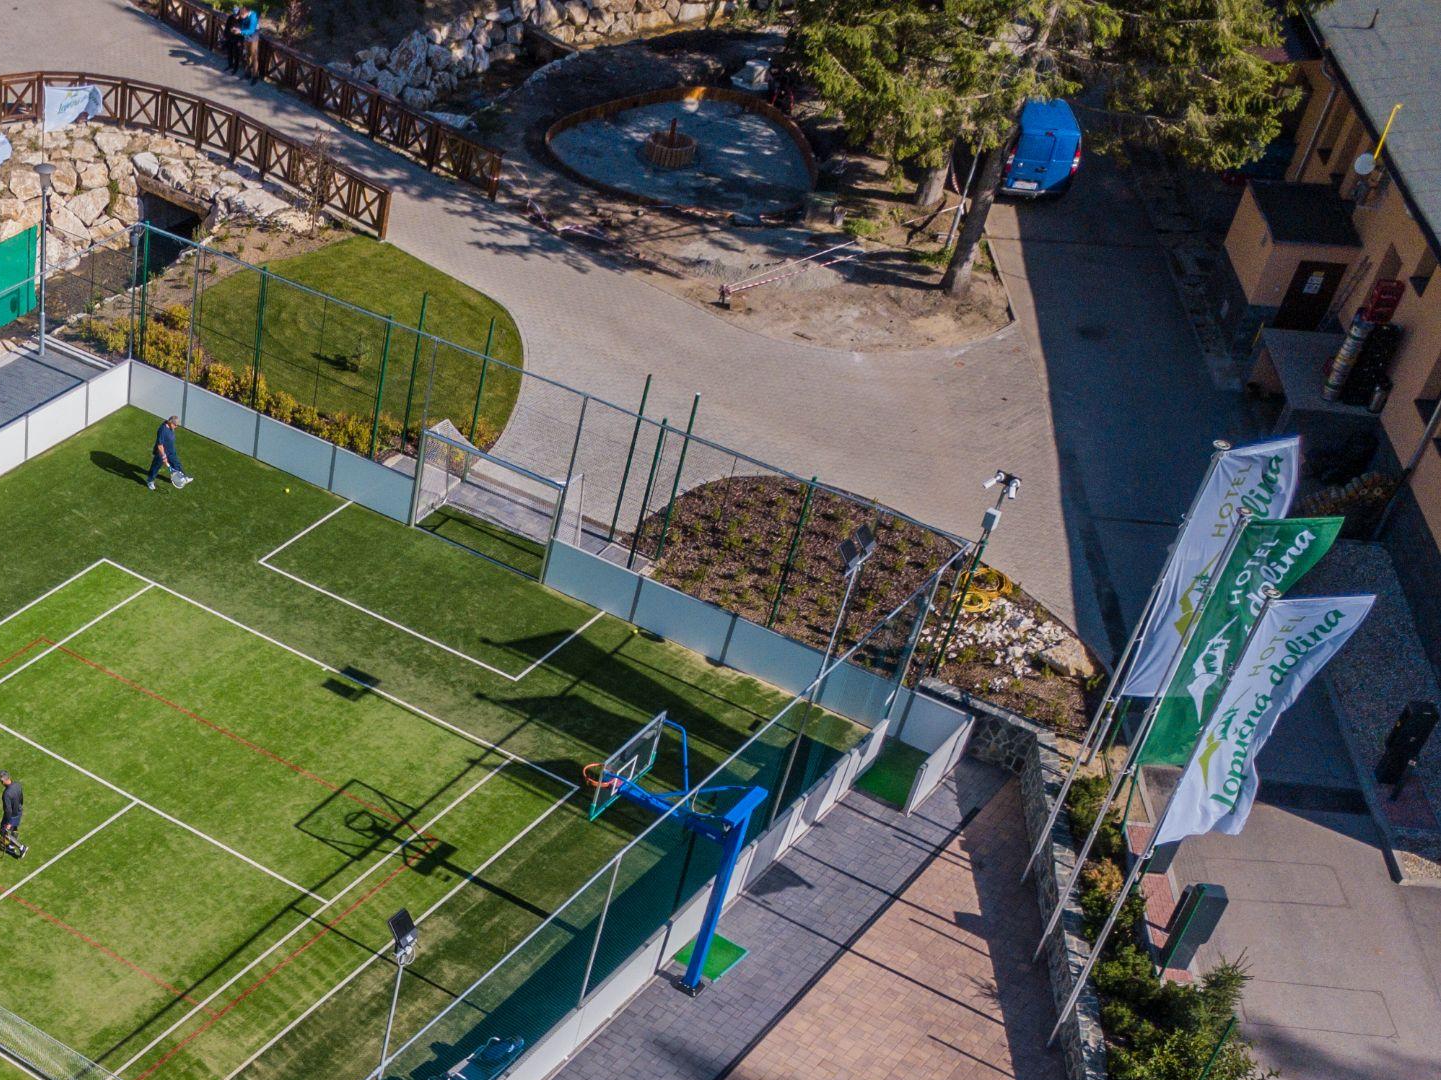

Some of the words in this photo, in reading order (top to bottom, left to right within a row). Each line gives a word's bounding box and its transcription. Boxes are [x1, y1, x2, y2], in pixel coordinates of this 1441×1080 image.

[1212, 463, 1253, 538] HOTEL
[1240, 454, 1284, 519] lina
[1229, 538, 1280, 605] HOTEL
[1248, 615, 1307, 677] HOTEL
[1267, 608, 1347, 687] dolina
